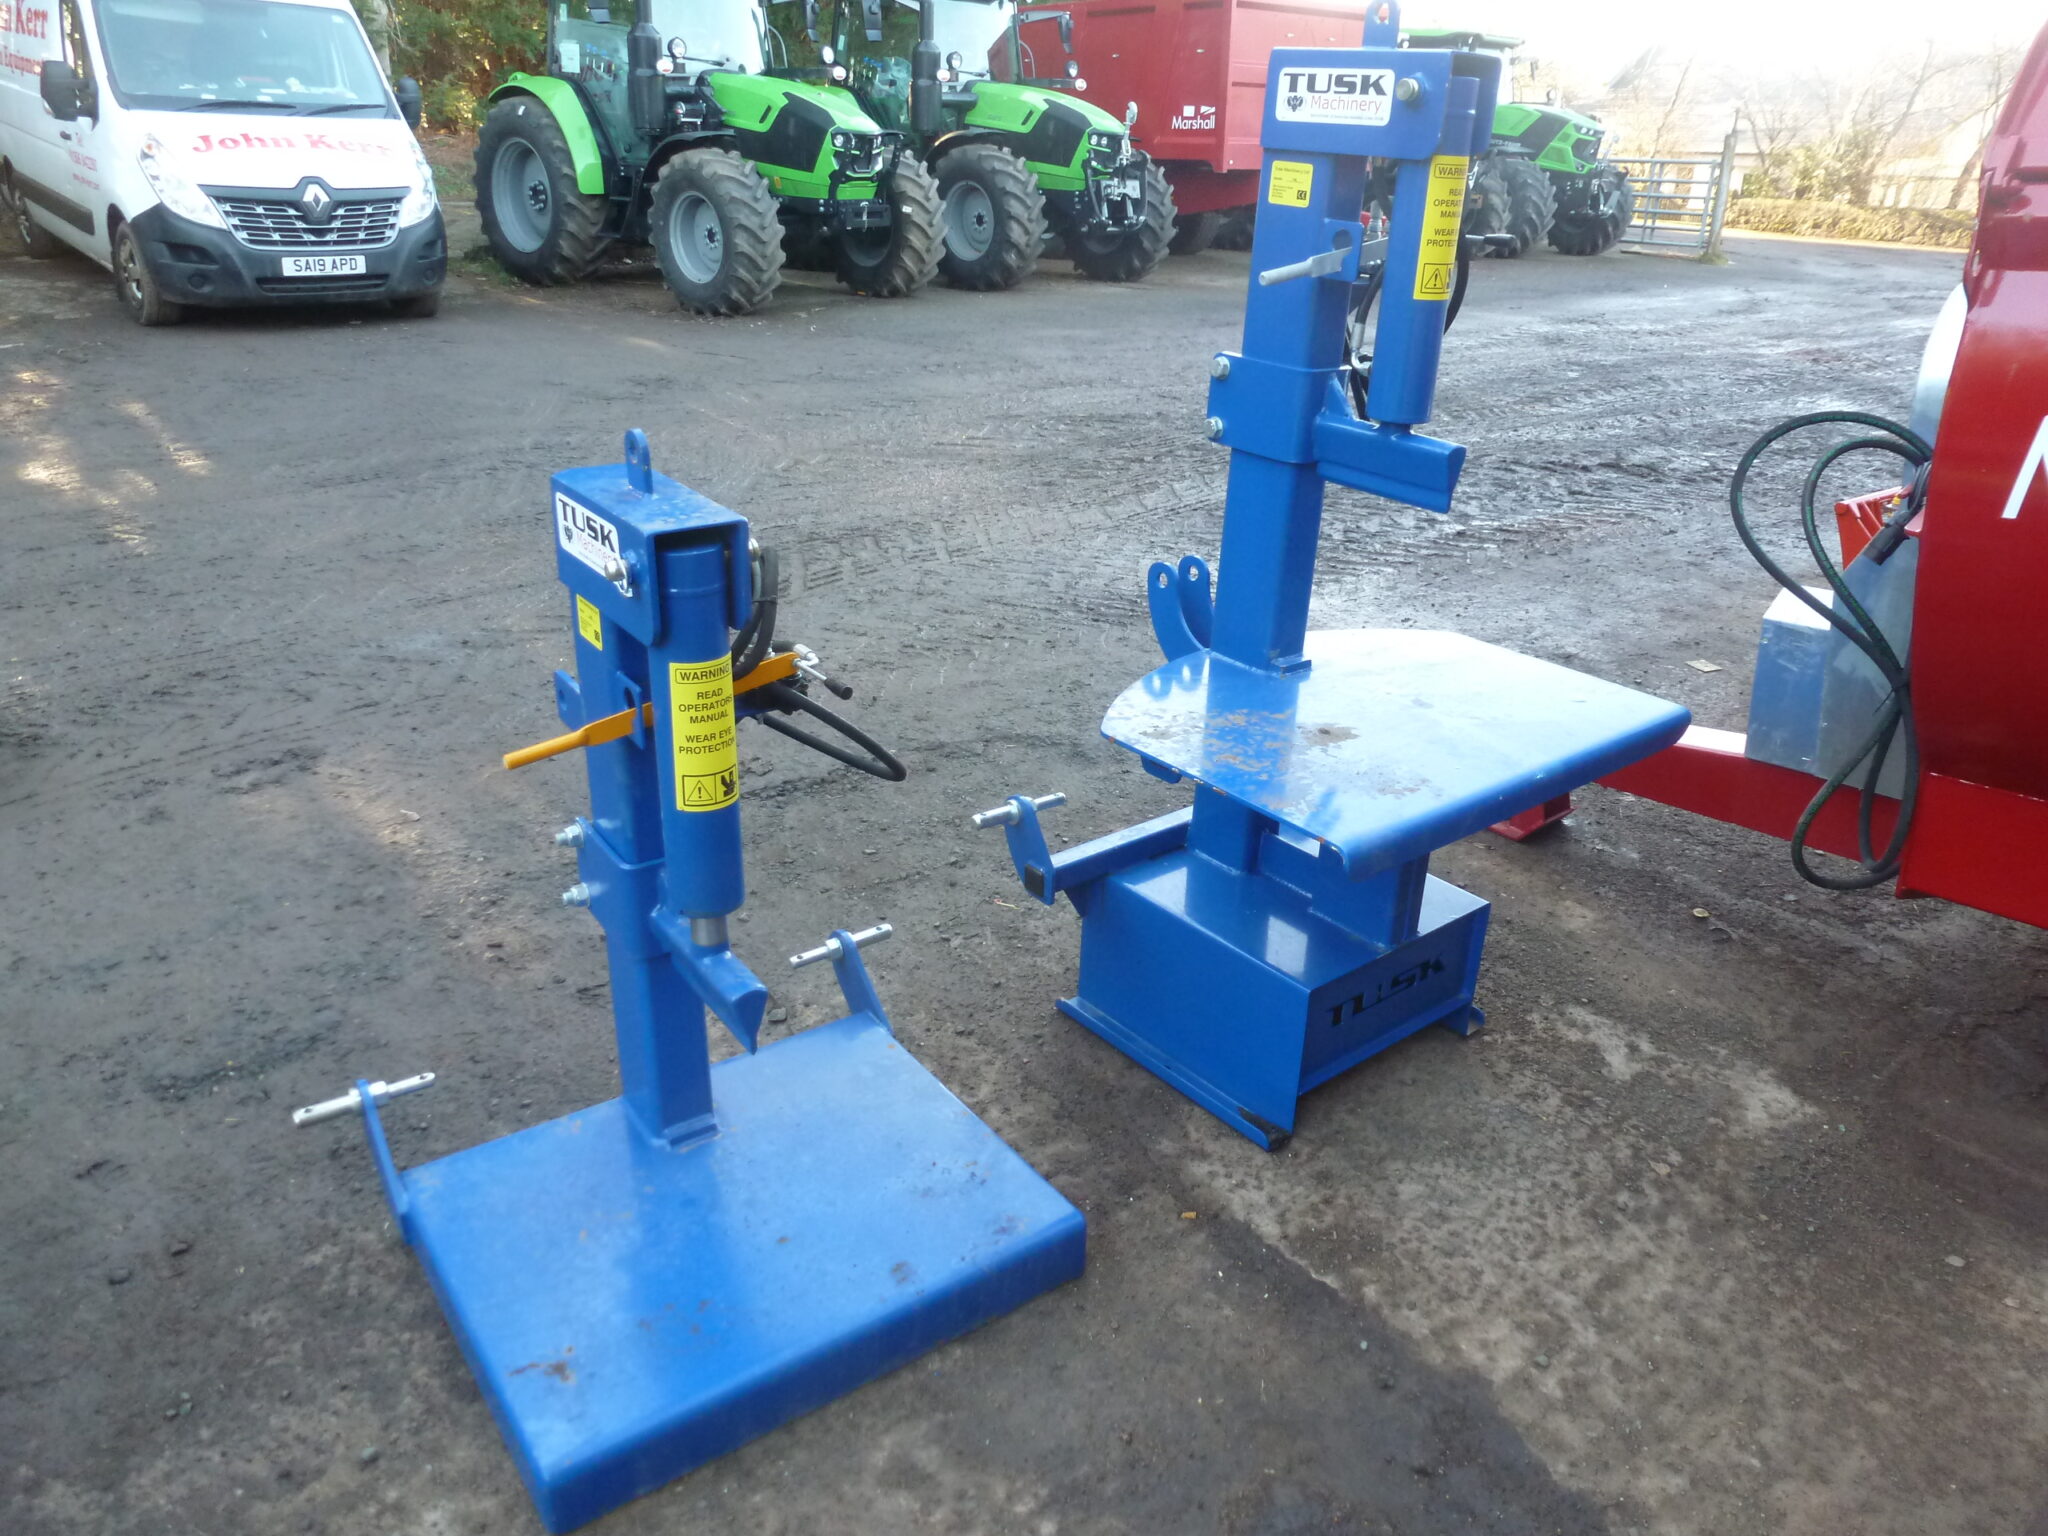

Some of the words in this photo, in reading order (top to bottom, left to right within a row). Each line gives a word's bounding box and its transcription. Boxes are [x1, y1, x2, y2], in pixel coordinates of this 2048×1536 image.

[1283, 73, 1387, 96] TUSK
[1310, 95, 1383, 115] Machinery
[1171, 114, 1216, 130] Marshall
[192, 133, 296, 153] John
[304, 134, 393, 157] Kerr
[293, 258, 326, 272] SA19
[331, 258, 358, 271] APD
[558, 498, 616, 553] TUSK
[679, 663, 730, 681] WARNING
[697, 687, 723, 700] READ
[690, 710, 728, 724] MANUAL
[685, 732, 717, 743] WEAR
[719, 726, 732, 739] EYE
[678, 736, 735, 755] PROTECTION
[1326, 957, 1445, 1027] TUSK
